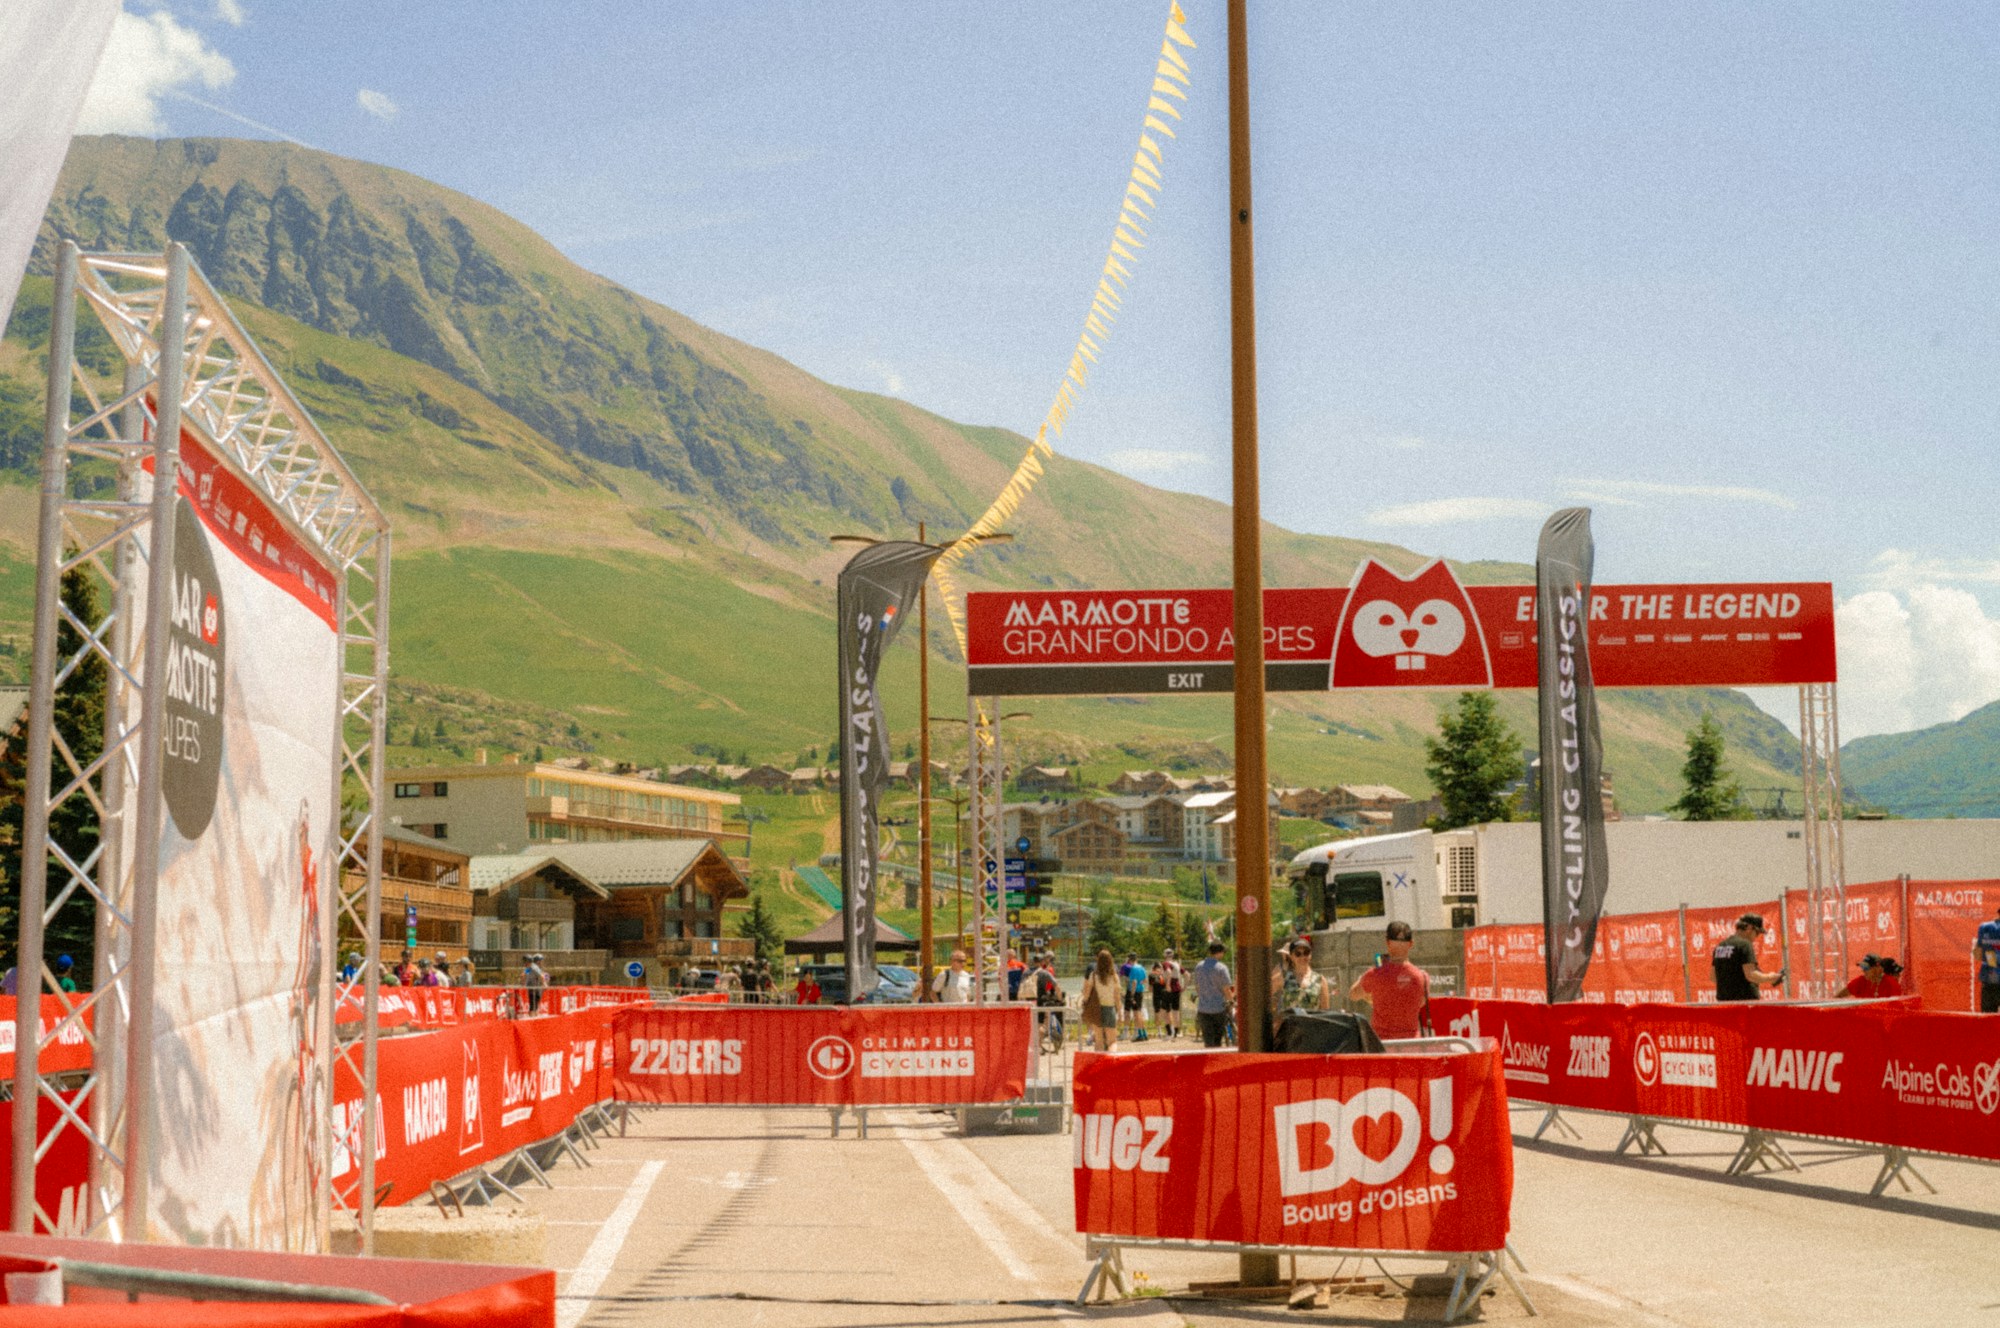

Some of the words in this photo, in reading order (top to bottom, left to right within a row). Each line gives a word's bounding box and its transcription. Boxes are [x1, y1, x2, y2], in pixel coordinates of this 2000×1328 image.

[1003, 598, 1190, 627] MARMOTTE
[1619, 593, 1673, 620] THE
[1683, 592, 1802, 620] LEGEND
[1003, 626, 1209, 656] GRANFONDO
[1217, 625, 1316, 654] APES
[1168, 672, 1204, 689] EXIT
[1559, 593, 1580, 773] CLASSICS
[1914, 890, 1984, 907] MARMOTTE
[1429, 974, 1456, 986] RANCE
[629, 1037, 743, 1076] 226ERS
[862, 1035, 975, 1049] GRIMPEUR
[869, 1057, 970, 1070] CYCLING
[1746, 1047, 1844, 1094] MAVIC
[1882, 1059, 1934, 1101] Alpine
[1935, 1063, 1972, 1098] Cols
[403, 1076, 448, 1147] HARIBO
[1926, 1095, 1936, 1106] UP
[1936, 1096, 1949, 1108] THE
[1951, 1097, 1974, 1110] POWER
[1283, 1200, 1354, 1226] Bourg
[1358, 1182, 1458, 1215] d'Oisans
